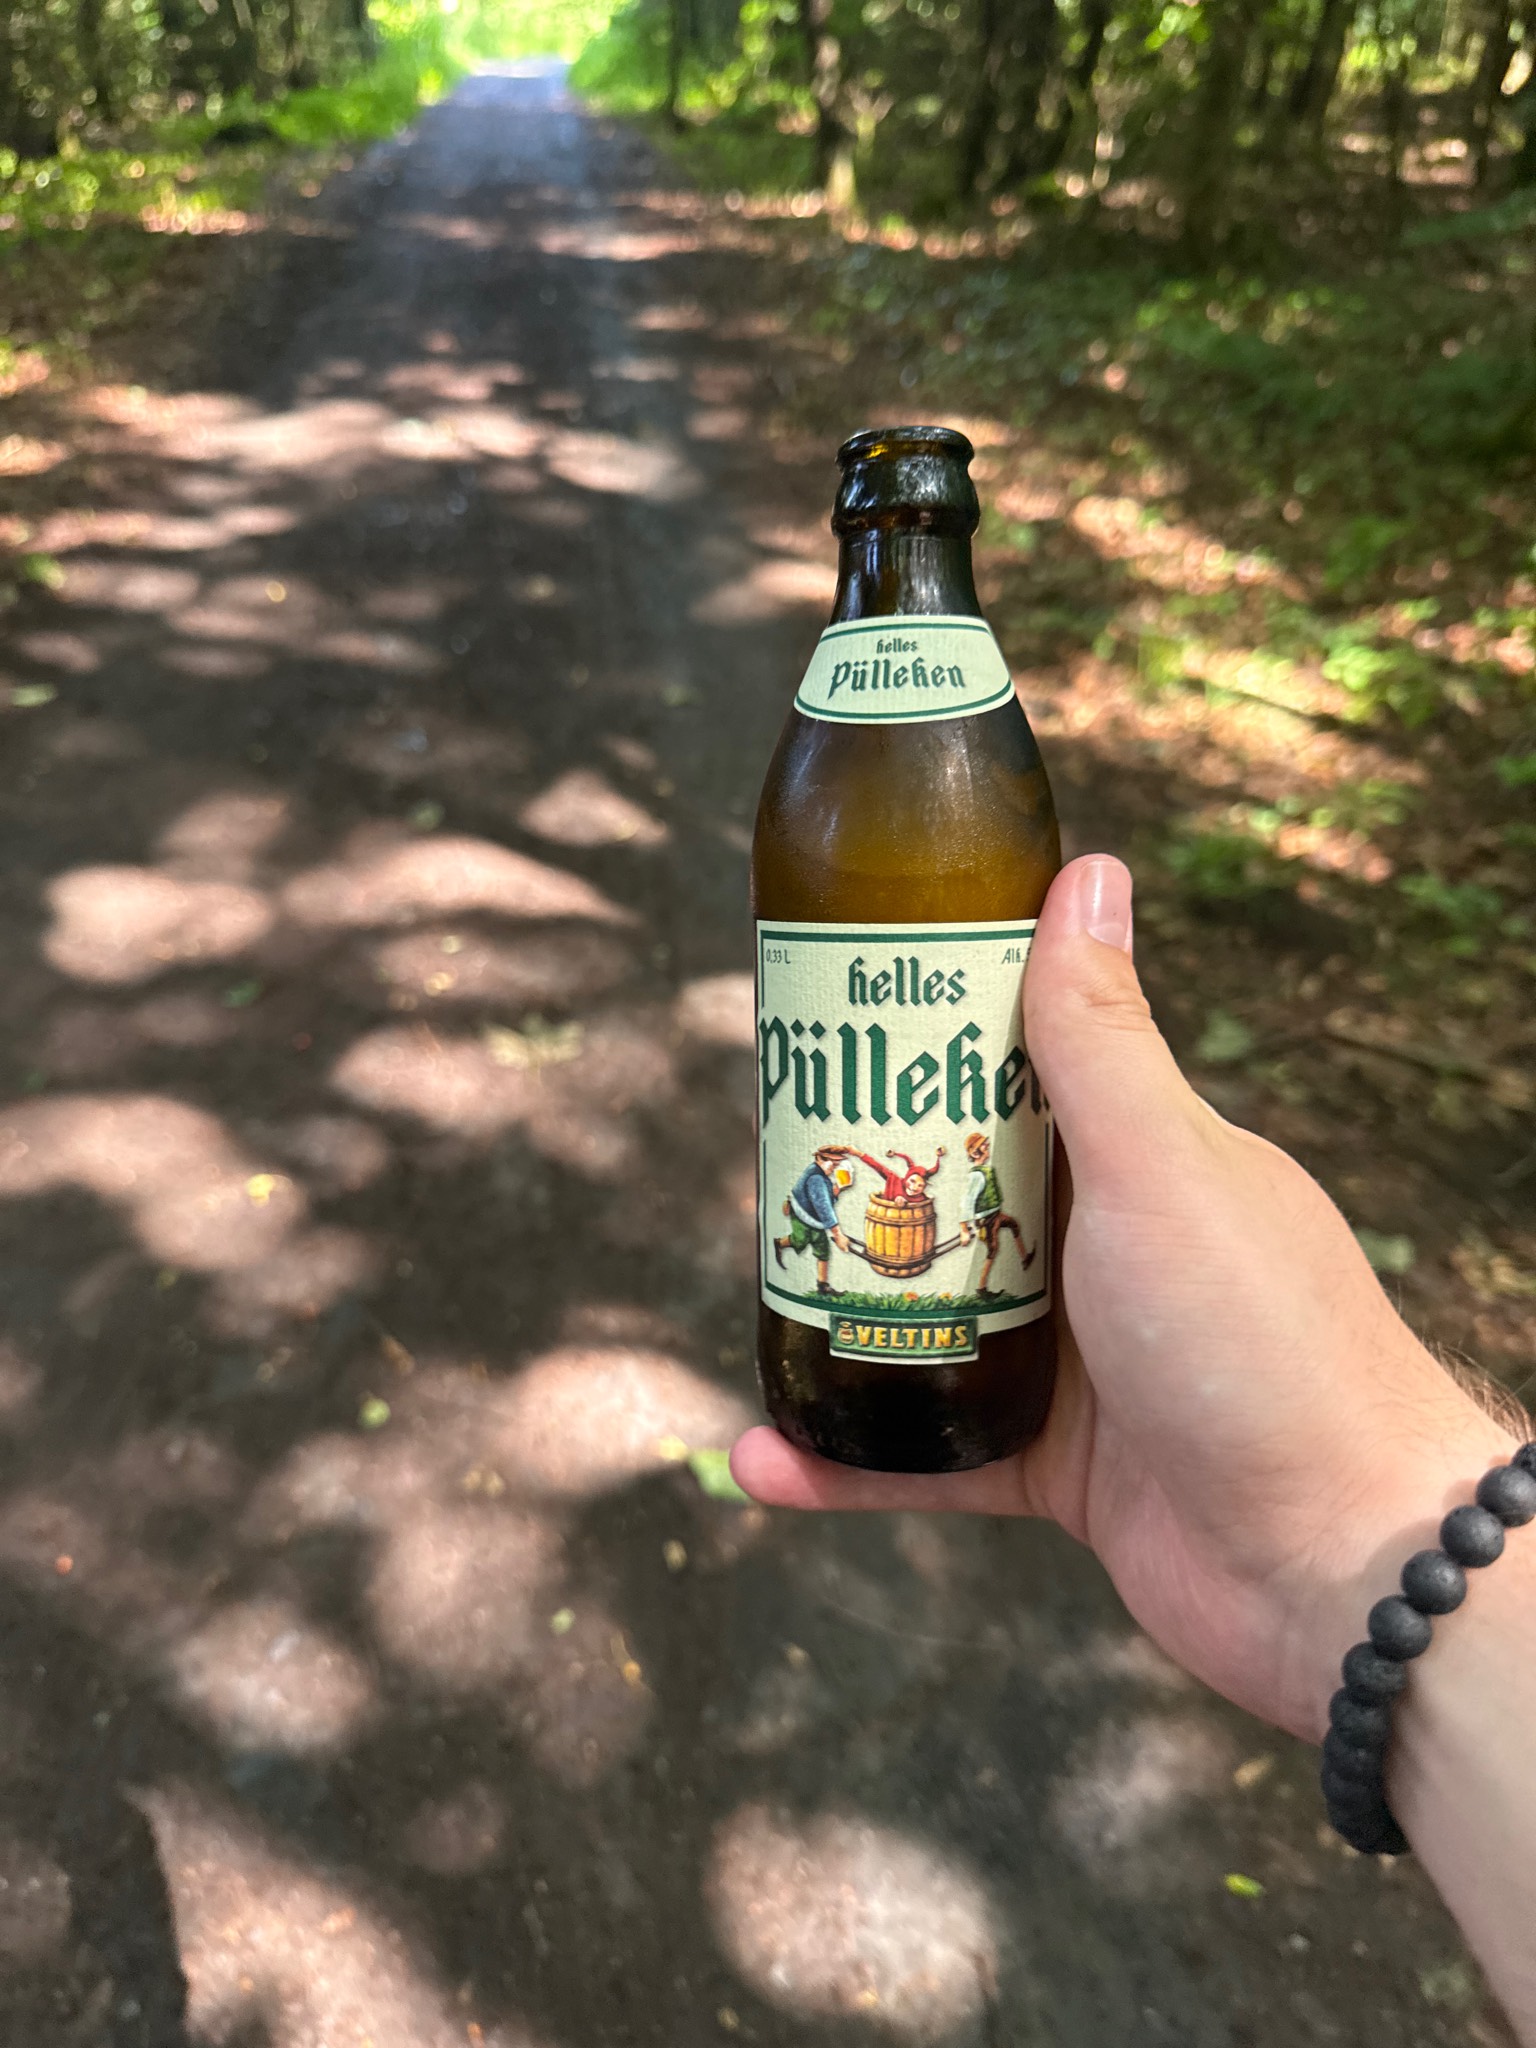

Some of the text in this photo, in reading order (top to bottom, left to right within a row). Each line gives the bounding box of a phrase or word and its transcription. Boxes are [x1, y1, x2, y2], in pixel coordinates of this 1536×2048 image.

[876, 637, 918, 654] helles
[848, 956, 967, 1006] helles
[855, 1325, 968, 1349] VELTINS
